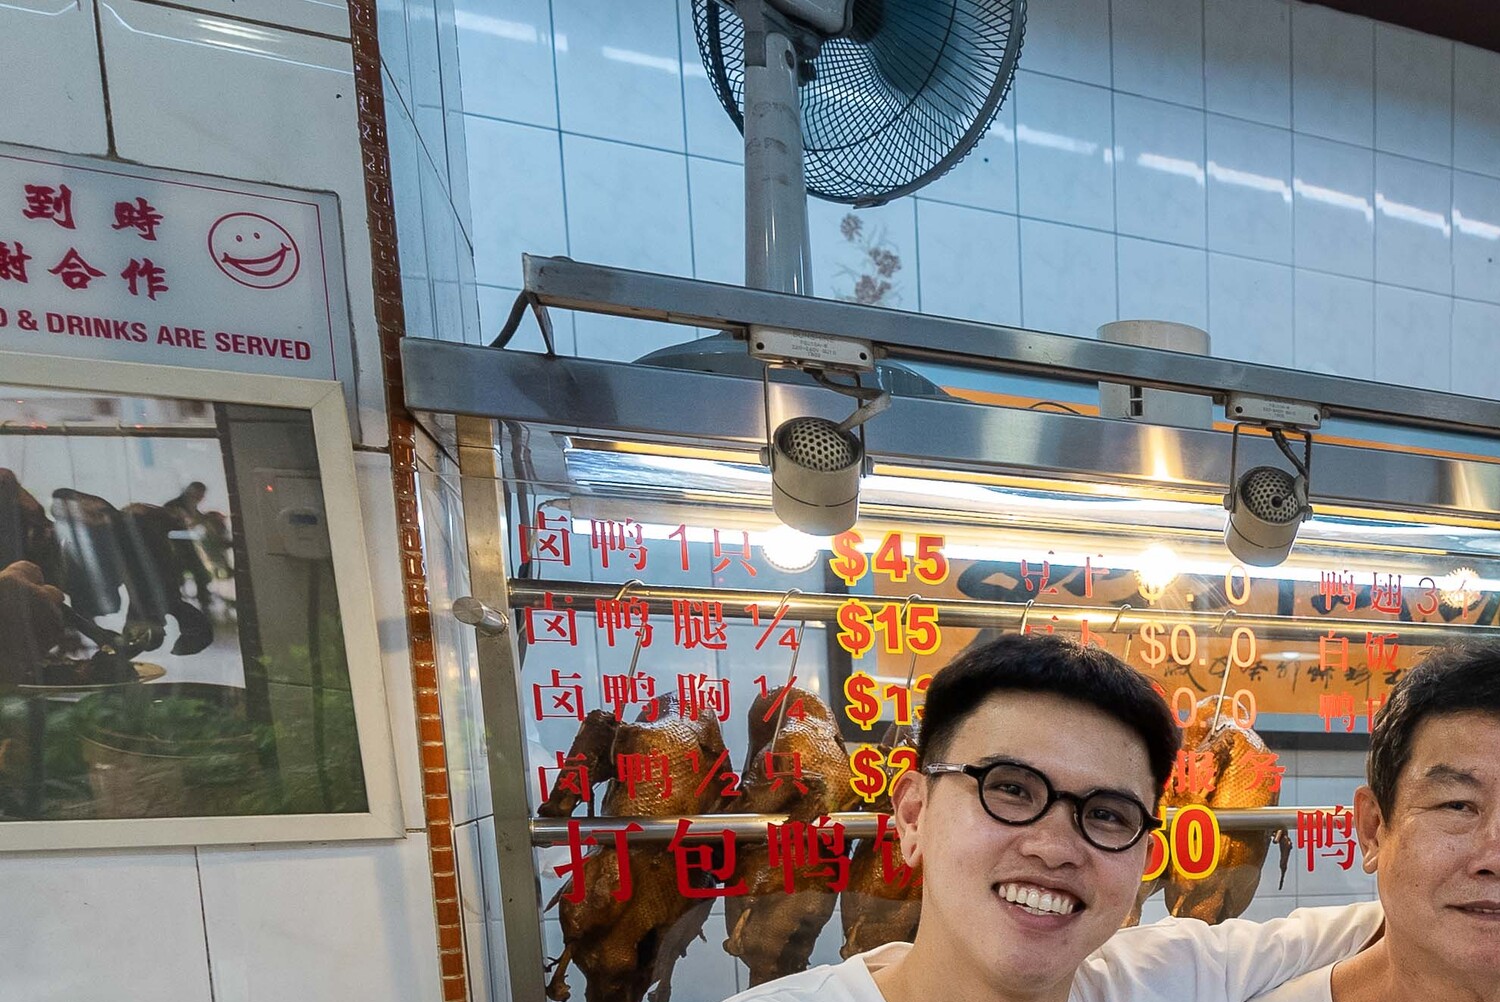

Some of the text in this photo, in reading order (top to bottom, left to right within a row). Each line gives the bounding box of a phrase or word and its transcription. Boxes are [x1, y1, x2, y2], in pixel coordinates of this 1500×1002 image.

[22, 183, 165, 241] 到時
[17, 309, 39, 331] &
[46, 312, 148, 343] DRINKS
[156, 325, 207, 350] ARE
[215, 332, 311, 361] SERVED
[829, 529, 949, 586] $45
[836, 598, 942, 658] $15
[1297, 804, 1355, 873] 鸭
